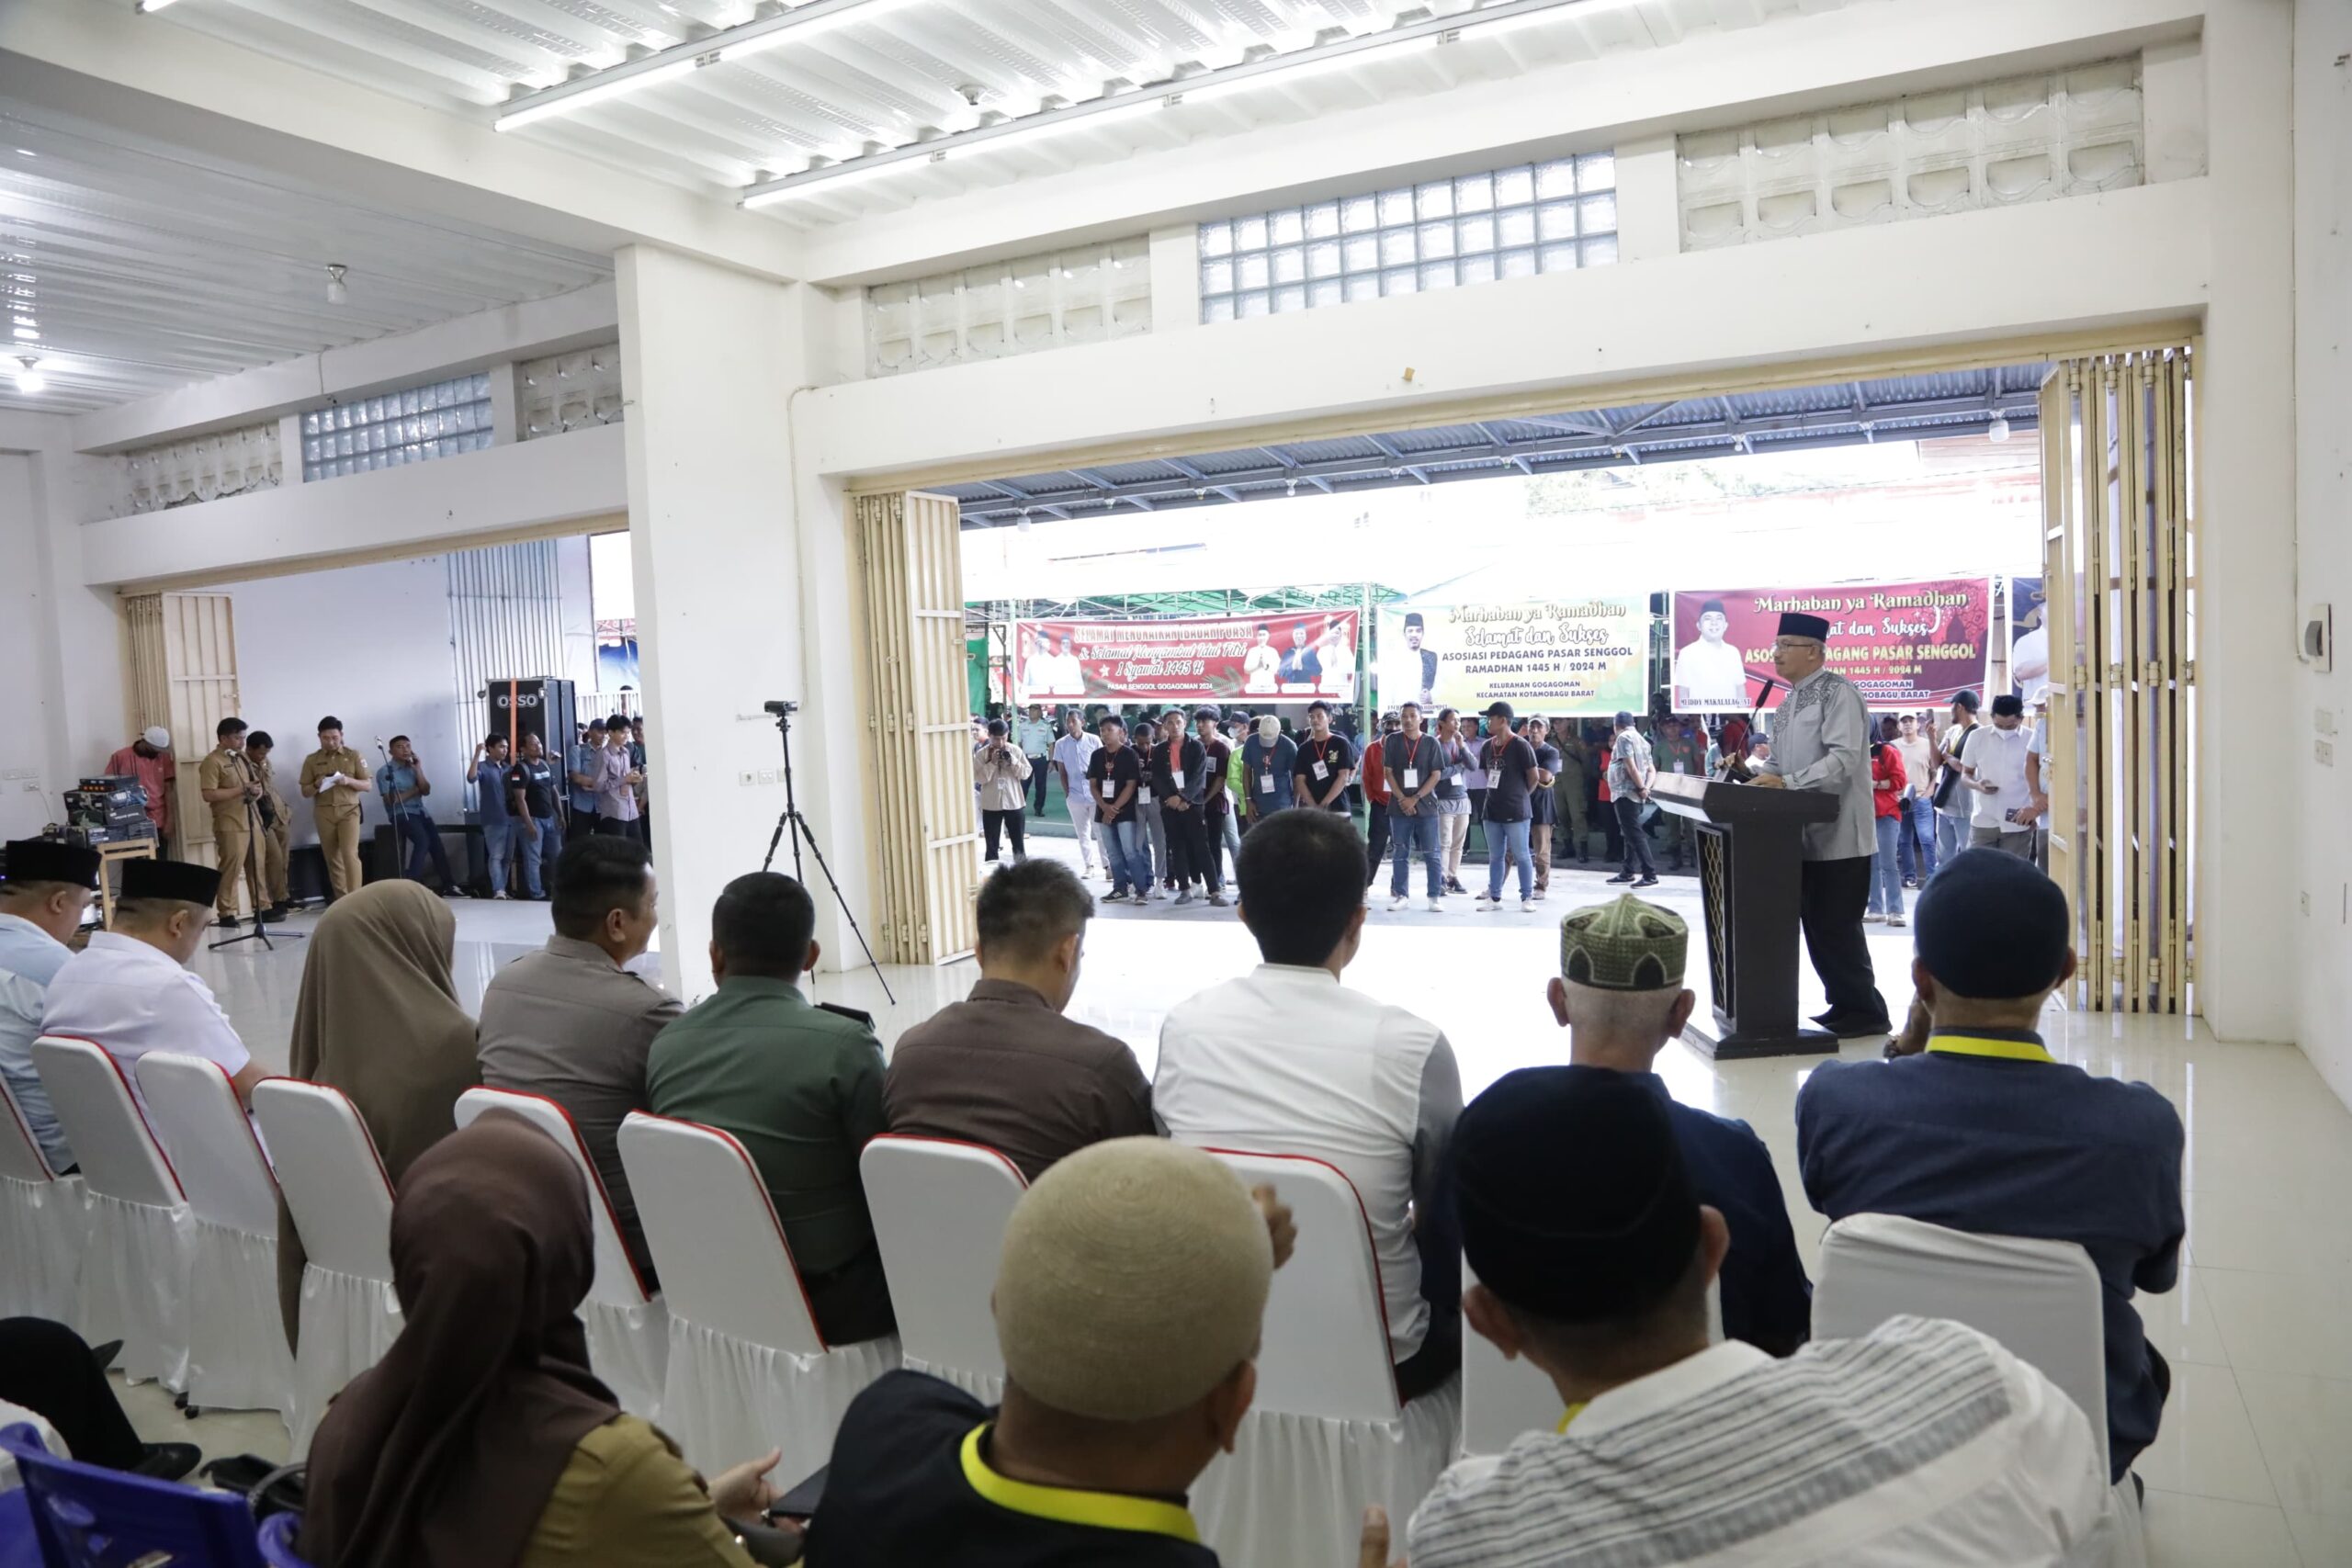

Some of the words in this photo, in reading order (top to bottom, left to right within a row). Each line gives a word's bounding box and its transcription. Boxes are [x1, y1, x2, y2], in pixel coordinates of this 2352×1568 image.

[1754, 595, 1841, 614] Marhaban
[1845, 598, 1865, 615] ya
[1870, 591, 1969, 608] Ramadhan
[1449, 605, 1521, 623] Marhaban
[1523, 609, 1542, 624] ya
[1545, 602, 1626, 620] Ramadhan
[1074, 626, 1114, 643] SELAMAT
[1179, 624, 1219, 640] IBADAH
[1219, 622, 1253, 639] PUASA
[1849, 619, 1876, 636] dan
[1882, 617, 1929, 637] Sukses
[1464, 626, 1524, 648] Selamat
[1525, 626, 1555, 645] dan
[1559, 622, 1609, 645] Sukses
[1079, 647, 1091, 660] &
[1091, 645, 1133, 660] Selamat
[1132, 644, 1194, 665] Menyambut
[1195, 643, 1221, 658] Idul
[1222, 642, 1247, 658] Fitri
[1442, 652, 1487, 661] ASOSIASI
[1490, 650, 1544, 660] PEDAGANG
[1548, 649, 1581, 658] PASAR
[1584, 647, 1633, 657] SENGGOL
[1826, 646, 1869, 661] AGANG
[1873, 646, 1913, 660] PASAR
[1917, 644, 1975, 660] SENGGOL
[1115, 661, 1124, 676] 1
[1124, 660, 1164, 682] Syawal
[1163, 660, 1192, 676] 1445
[1193, 660, 1204, 675] H
[1465, 663, 1522, 673] RAMADHAN
[1527, 662, 1550, 672] 1445
[1554, 662, 1560, 671] H
[1569, 661, 1594, 671] 2024
[1598, 661, 1607, 671] M
[1849, 665, 1871, 675] 1445
[1872, 665, 1881, 674] H
[1888, 664, 1911, 674] 2024
[1914, 664, 1922, 674] M
[1107, 682, 1127, 691] PASAR
[1128, 682, 1157, 691] SENGGOL
[1199, 682, 1213, 690] 2024
[1854, 681, 1913, 689] GOGAGOMAN
[497, 694, 538, 708] OSO
[1476, 691, 1517, 699] KECAMATAN
[1519, 690, 1569, 698] KOTAMOBAGU
[1900, 691, 1929, 699] BARAT
